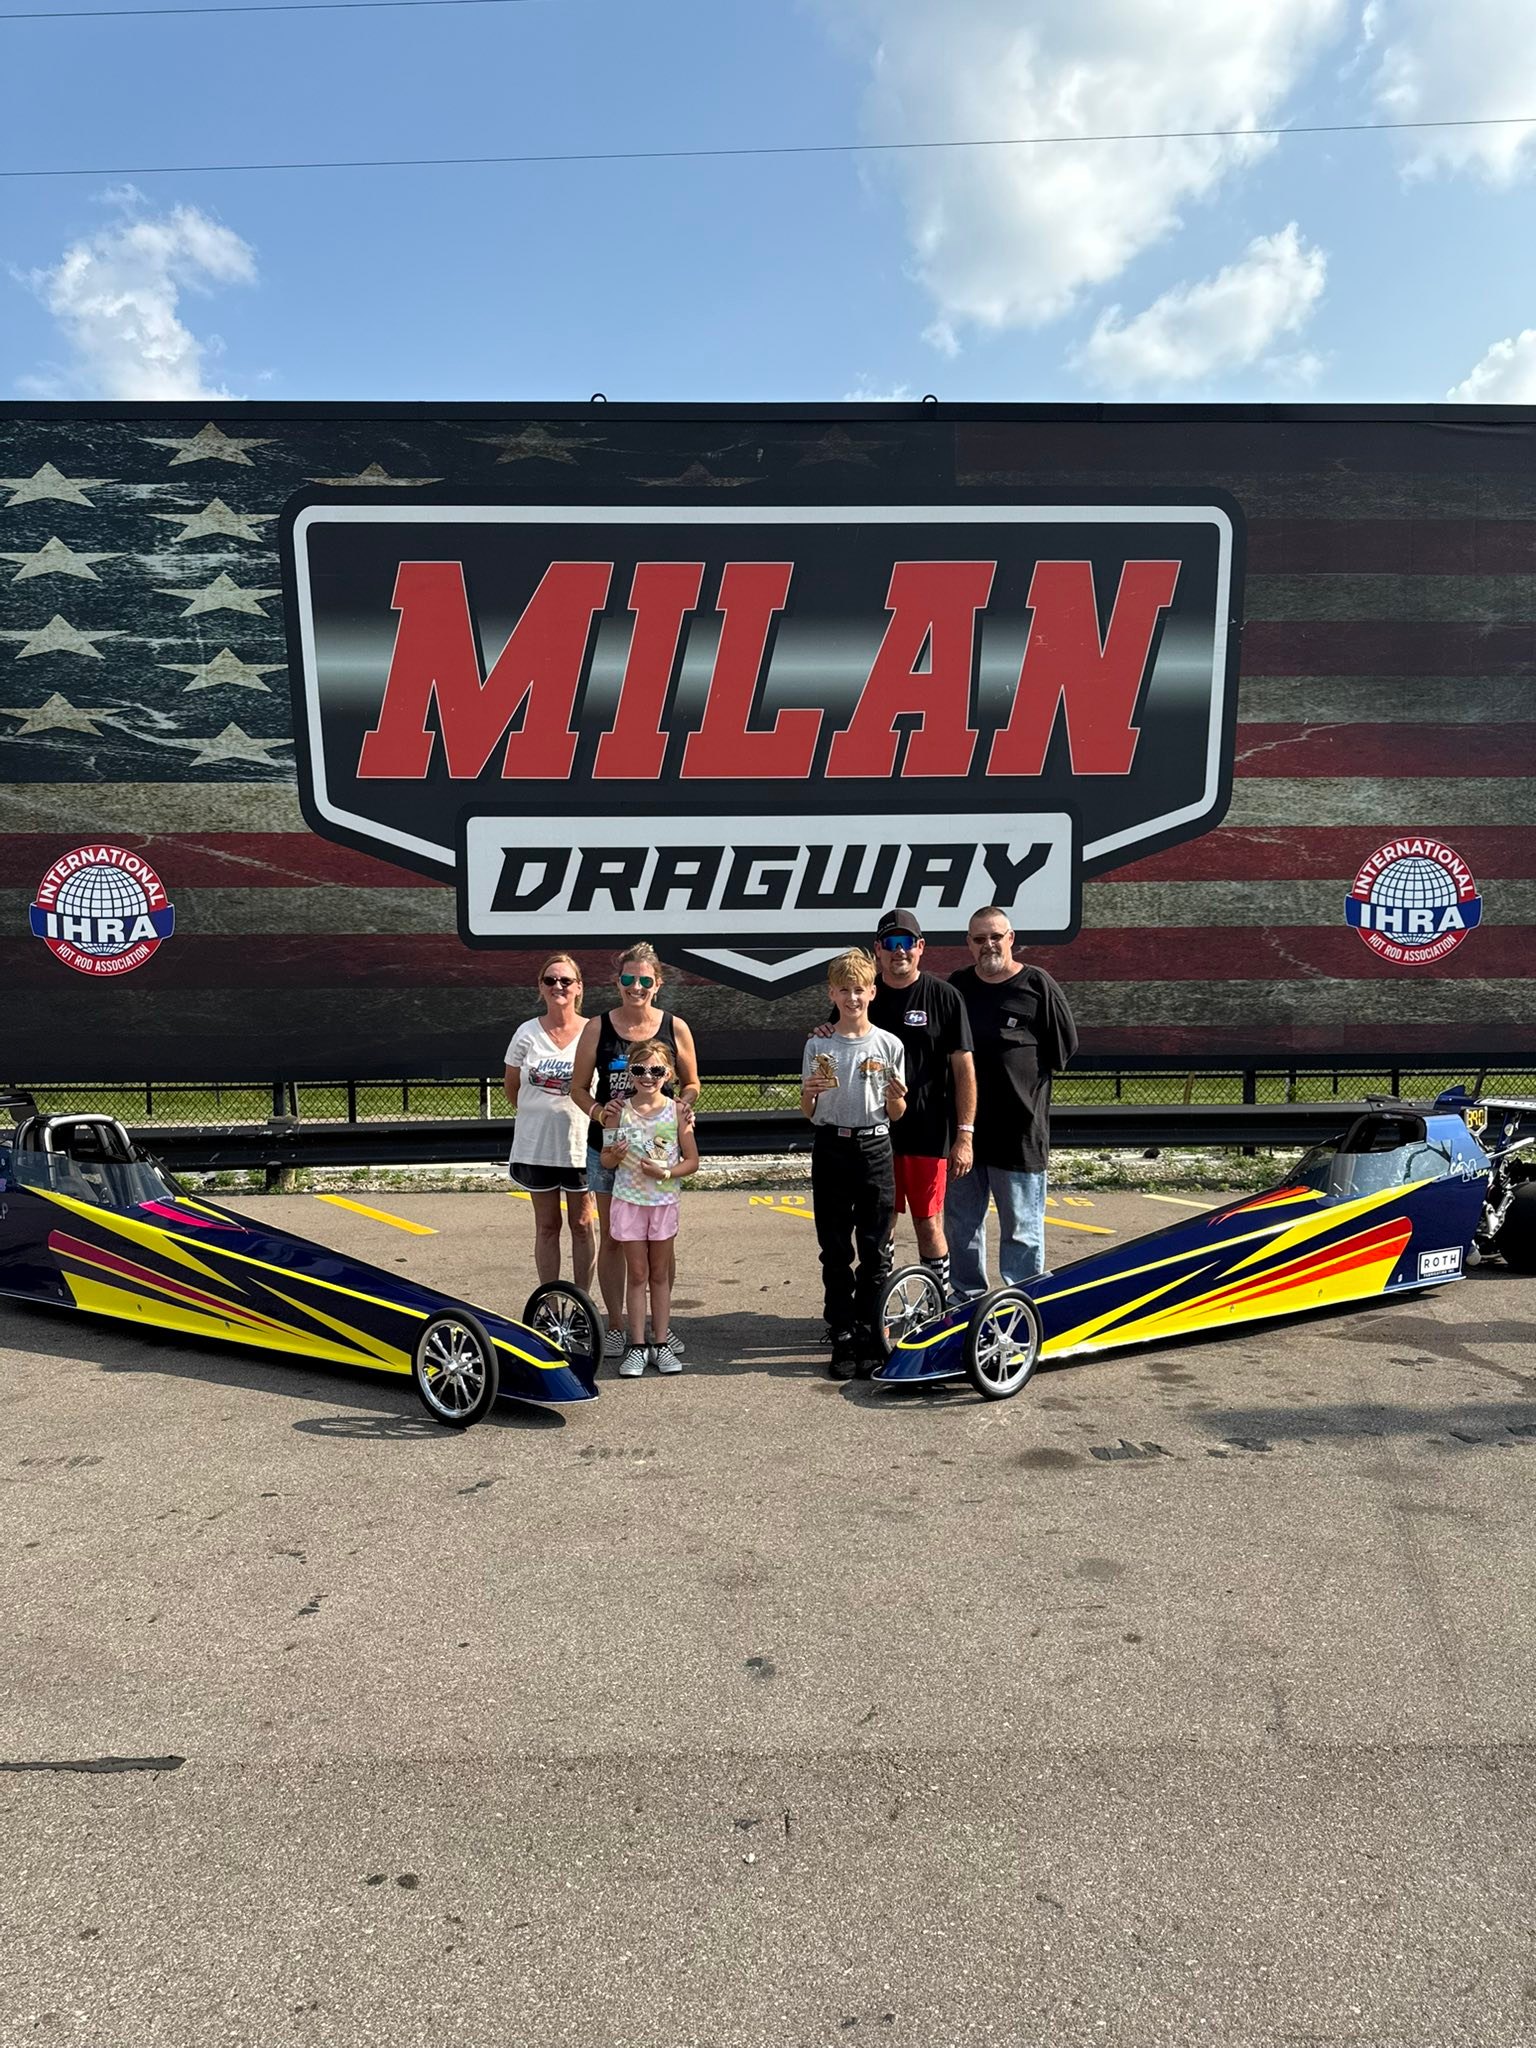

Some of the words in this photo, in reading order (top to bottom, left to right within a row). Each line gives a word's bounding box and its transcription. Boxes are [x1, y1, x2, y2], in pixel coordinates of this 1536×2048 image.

[356, 560, 1183, 779] MILAN
[39, 848, 165, 906] INTERNATIONAL
[490, 842, 1054, 912] DRAGWAY
[1354, 839, 1474, 897] INTERNATIONAL
[46, 912, 158, 942] IHRA
[1360, 903, 1466, 933] IHRA
[56, 943, 73, 961] HOT
[74, 955, 92, 970] ROD
[95, 944, 151, 972] ASSOCIATION
[1368, 933, 1384, 951] HOT
[1384, 946, 1402, 960] ROD
[1403, 934, 1458, 962] ASSOCIATION
[536, 1058, 573, 1073] Milan
[749, 1195, 806, 1206] NO
[1423, 1254, 1457, 1269] ROTH
